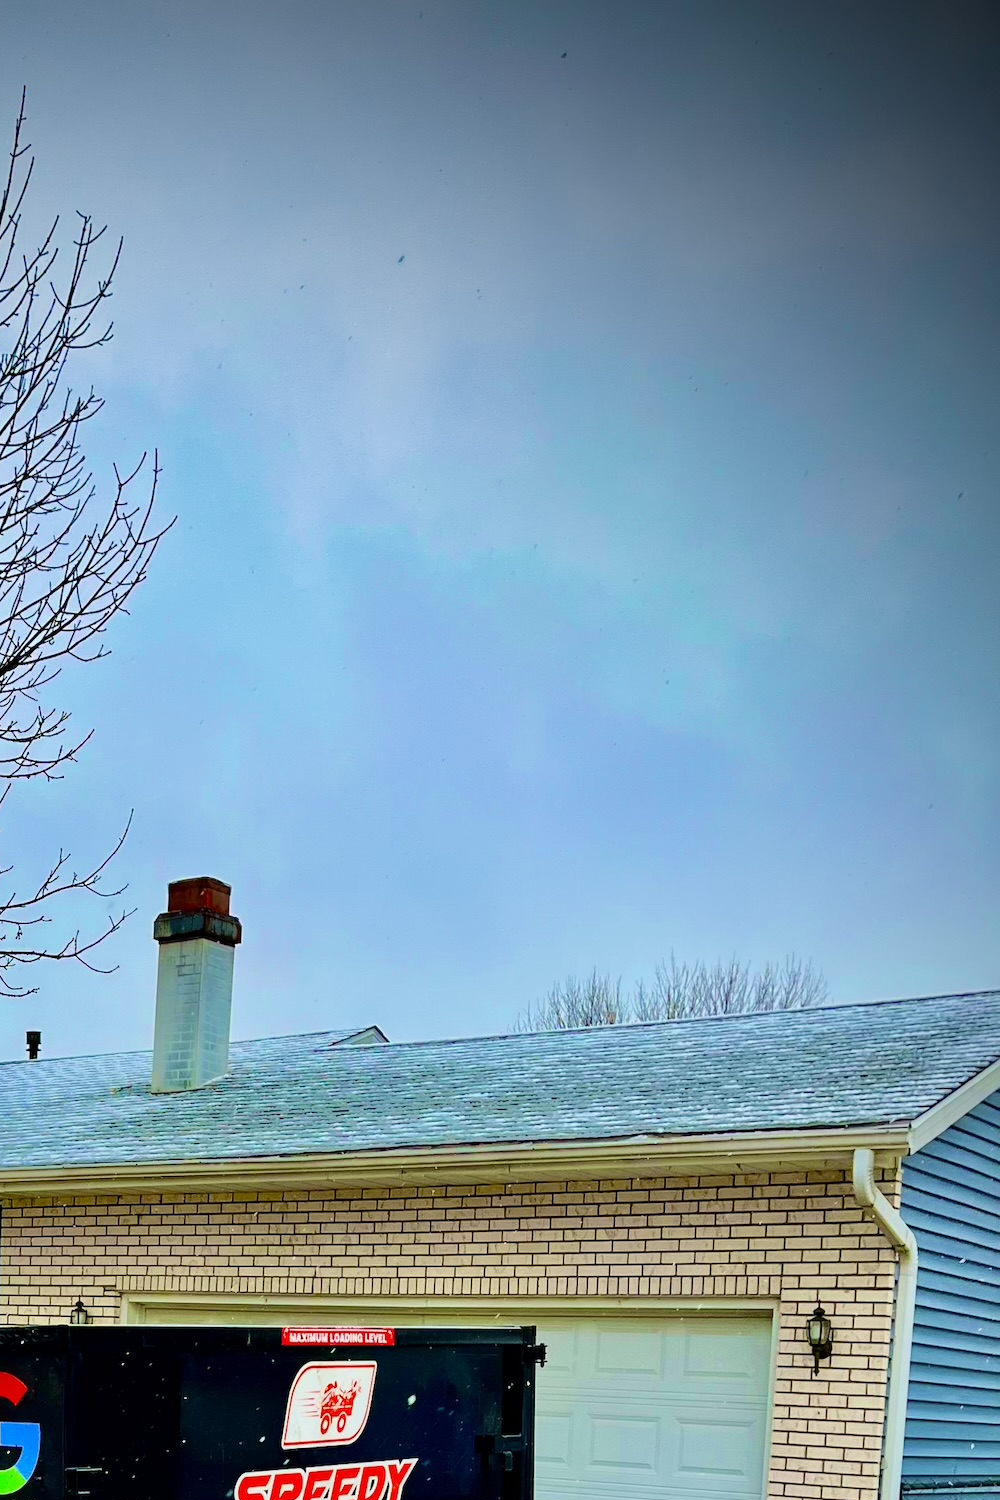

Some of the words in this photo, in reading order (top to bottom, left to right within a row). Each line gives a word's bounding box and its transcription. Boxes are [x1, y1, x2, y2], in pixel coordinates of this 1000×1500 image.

[289, 1333, 328, 1343] MAXIMUM
[330, 1333, 363, 1343] LOADING
[365, 1333, 387, 1344] LEVEL
